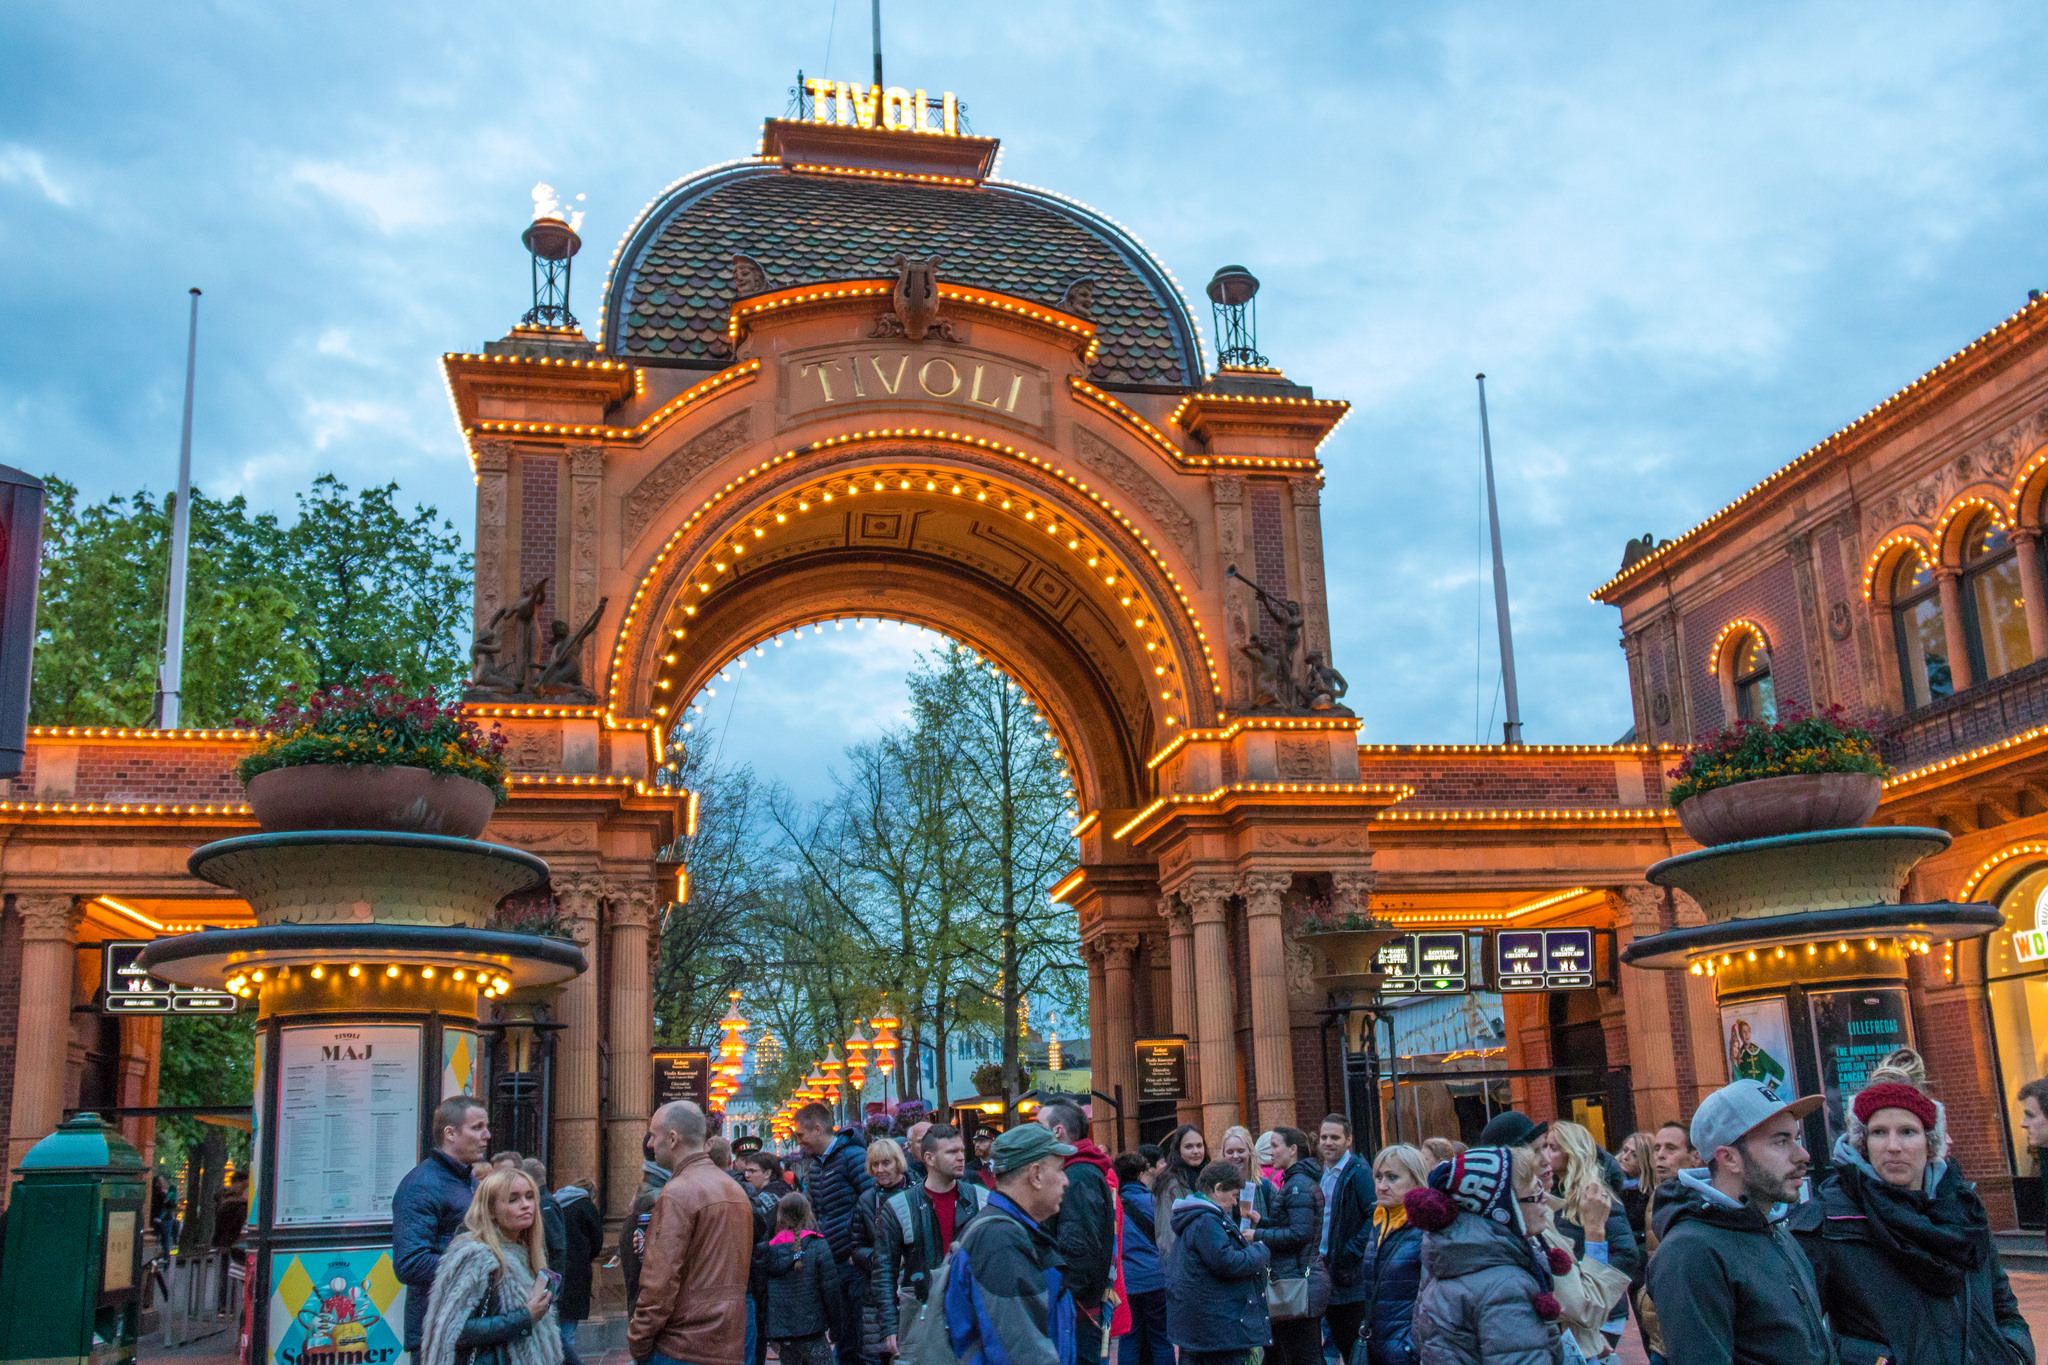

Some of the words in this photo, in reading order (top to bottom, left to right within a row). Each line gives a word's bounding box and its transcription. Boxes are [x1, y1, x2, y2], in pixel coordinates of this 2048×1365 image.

[805, 78, 958, 136] TIVOLI
[801, 353, 1025, 414] TIVOLI
[1848, 1019, 1899, 1036] LILLEFREDAG
[334, 1032, 361, 1040] TIVOLI
[321, 1044, 374, 1062] MAJ
[1836, 1047, 1848, 1056] THE
[1849, 1046, 1876, 1055] RUMOUR
[1876, 1044, 1890, 1054] SAID
[1837, 1063, 1853, 1072] LORD
[1838, 1071, 1866, 1082] CANCER
[327, 1261, 351, 1269] TIVOLI
[281, 1346, 394, 1365] Sommer
